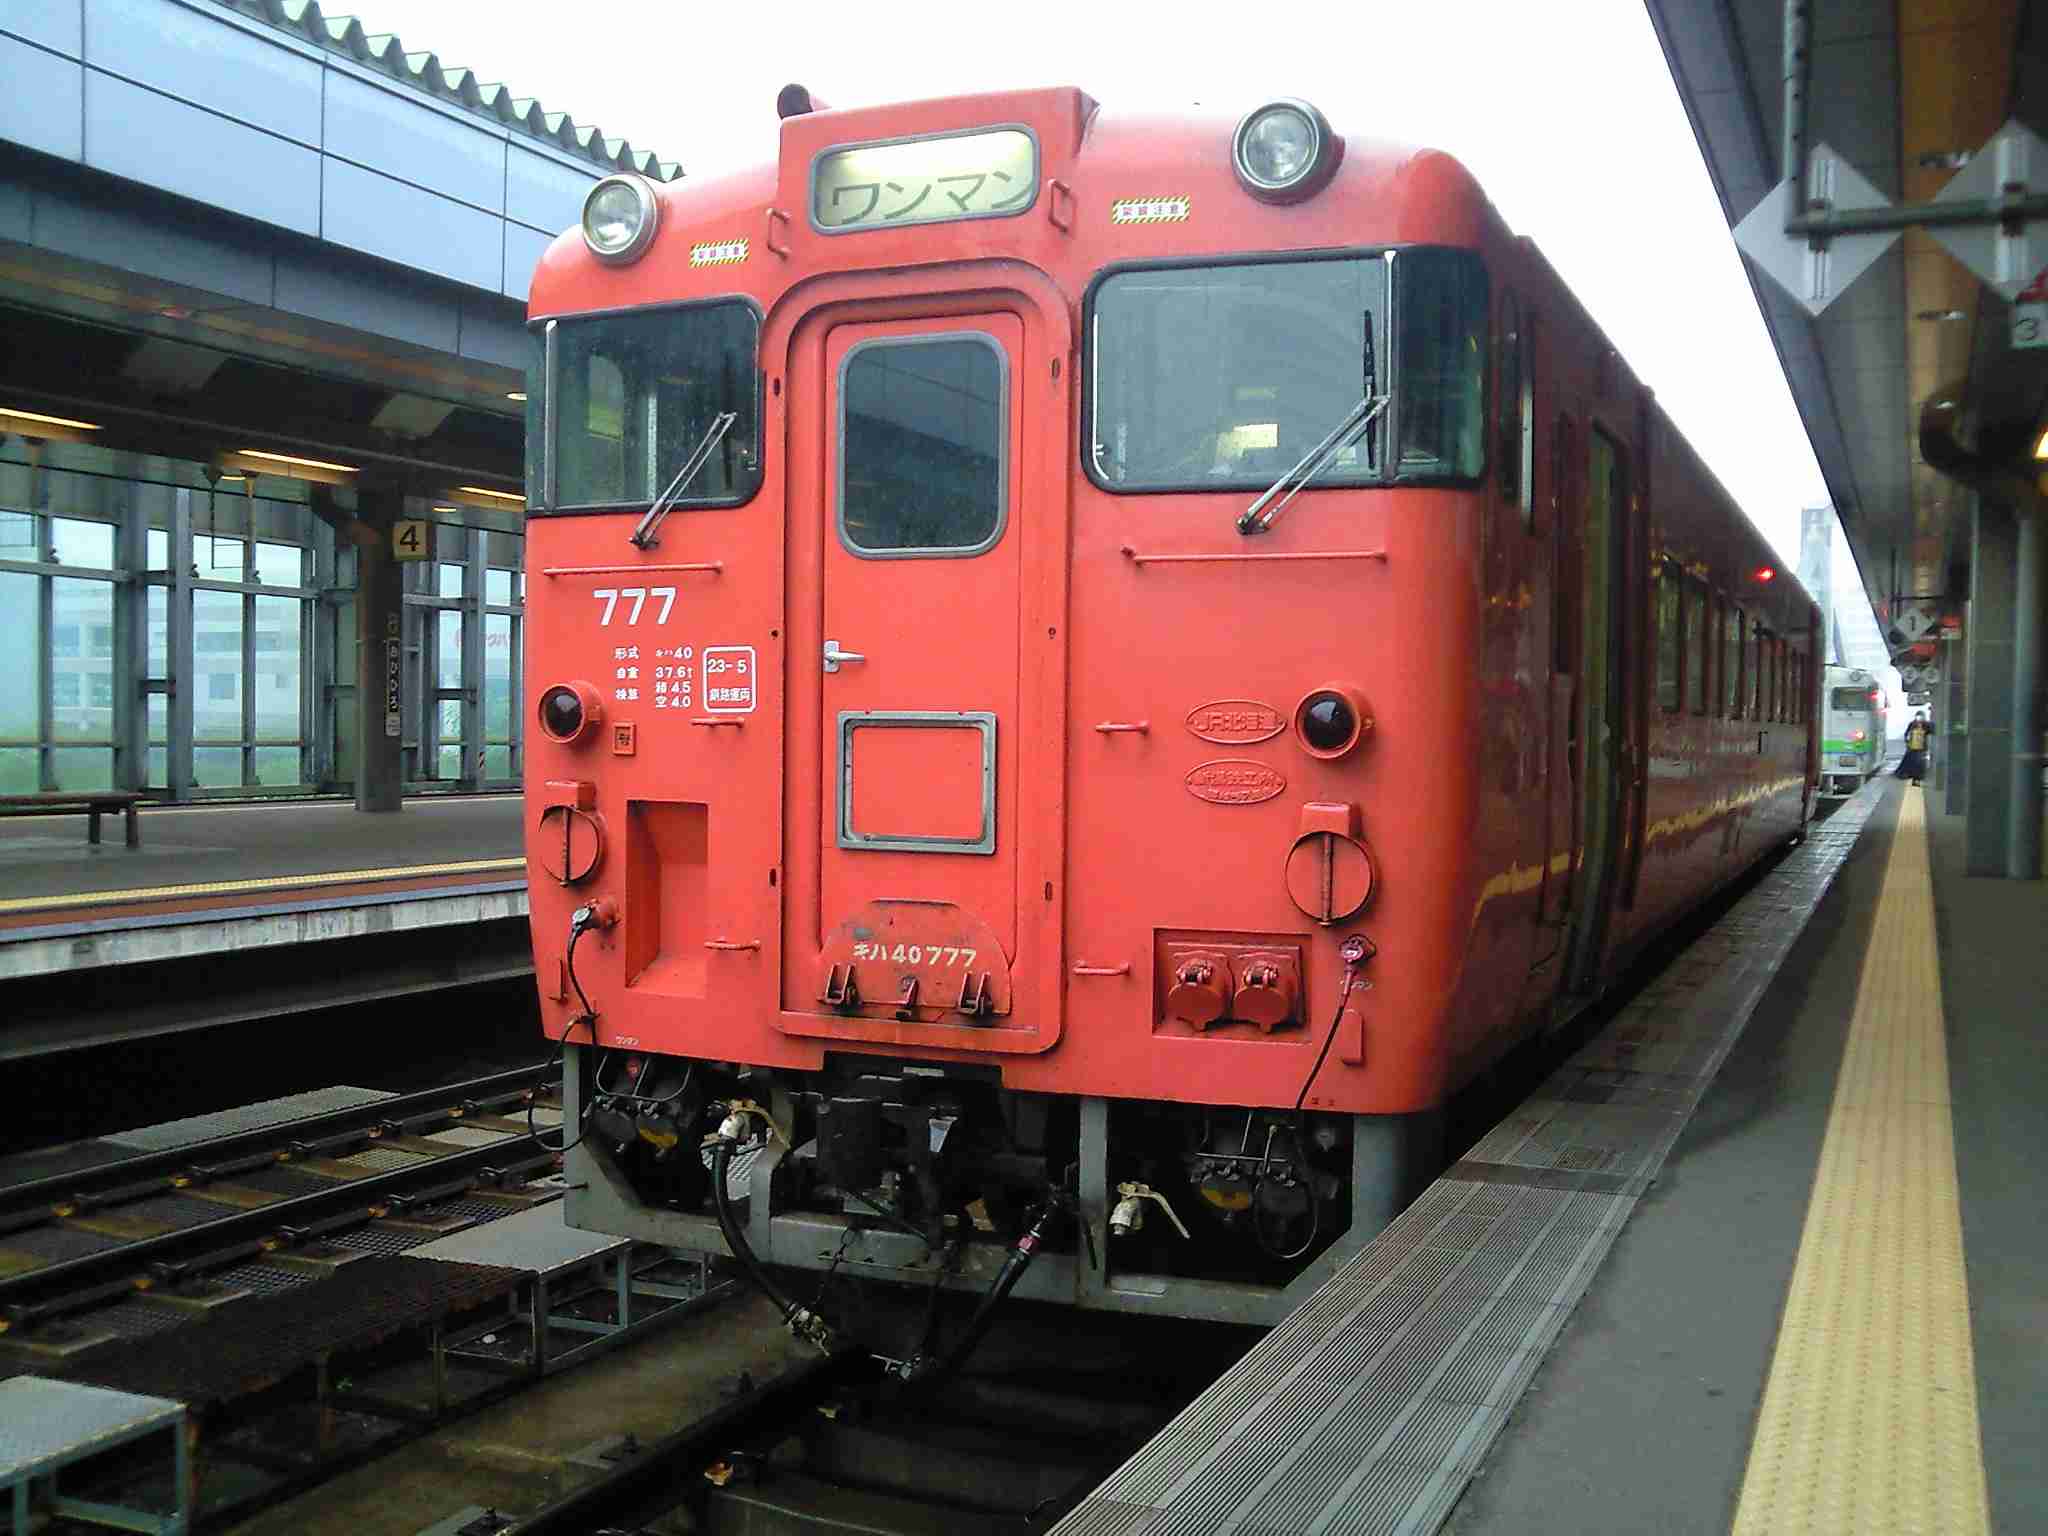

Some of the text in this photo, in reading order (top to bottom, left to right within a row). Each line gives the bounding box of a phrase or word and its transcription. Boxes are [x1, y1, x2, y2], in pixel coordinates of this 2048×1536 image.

[832, 170, 1034, 225] ワンマン
[399, 524, 420, 552] 4
[593, 587, 676, 625] 777
[614, 645, 640, 660] 形式
